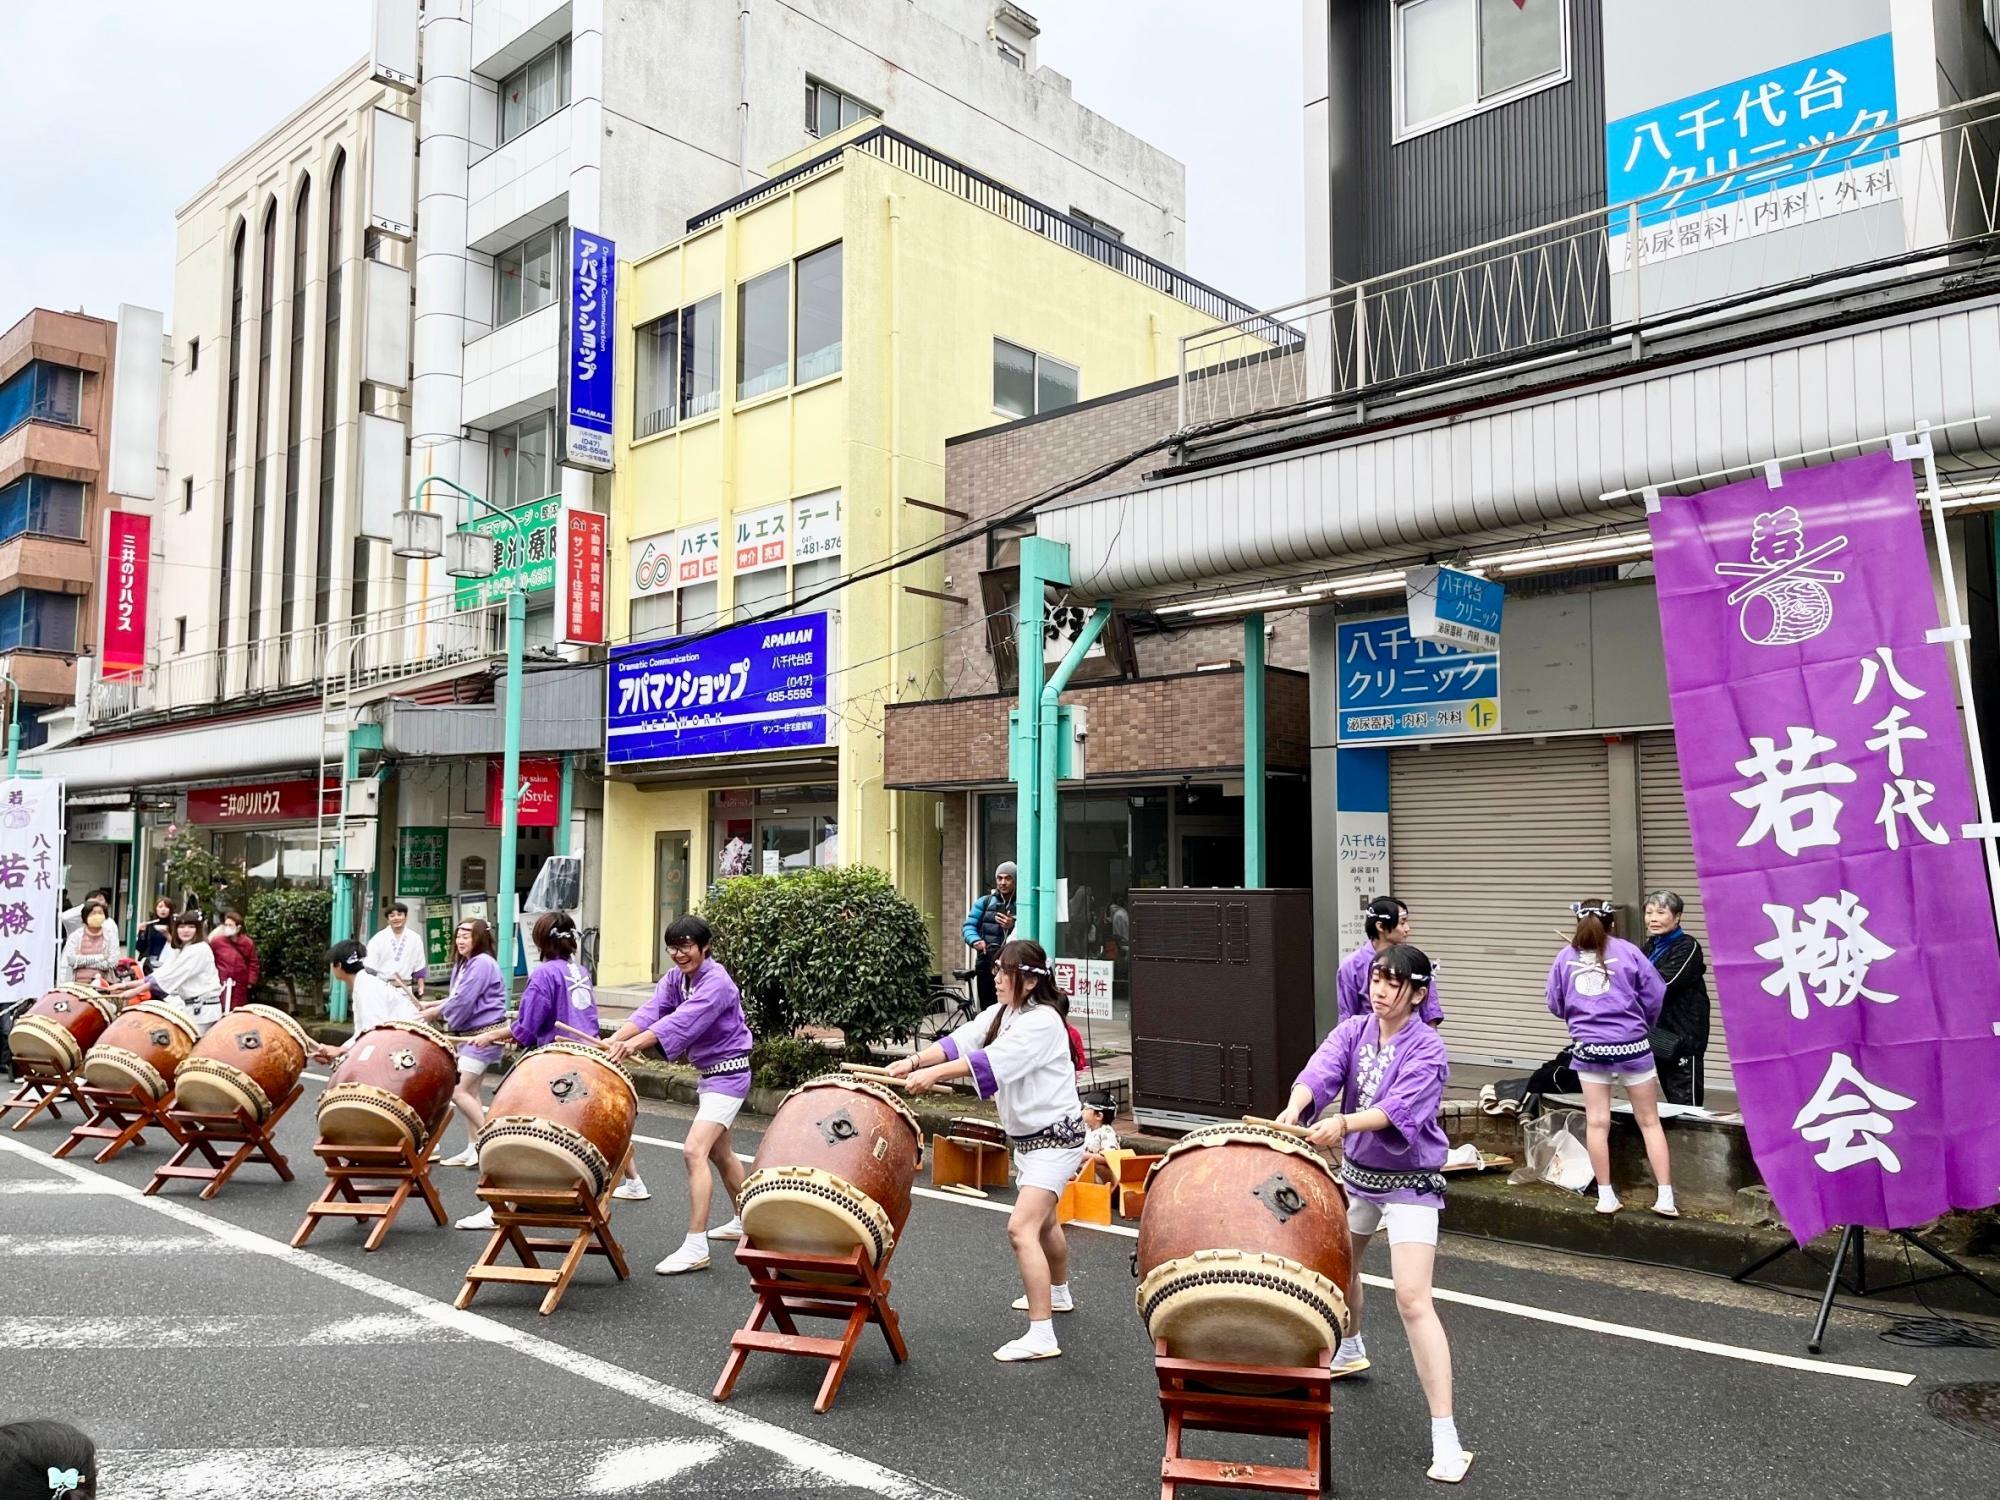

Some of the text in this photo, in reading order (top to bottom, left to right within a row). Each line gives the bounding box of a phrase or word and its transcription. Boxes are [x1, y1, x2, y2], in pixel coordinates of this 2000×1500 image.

[1623, 66, 1848, 173] 八千代台
[1657, 108, 1889, 211] クリニック
[579, 238, 598, 381] アパマンショップ
[600, 245, 610, 352] Dramatic Communication
[576, 407, 606, 420] APAMAN
[738, 550, 755, 566] 仲介
[116, 533, 137, 633] 三井のリハウス
[1441, 573, 1484, 603] 八千代台
[1455, 600, 1500, 628] クリニック
[762, 628, 813, 650] APAMAN
[618, 652, 700, 672] Dramatic Communication
[771, 652, 813, 670] 八千代台店
[617, 656, 751, 715] アパマンショップ
[786, 674, 813, 689] (047)
[1346, 659, 1487, 701] クリニック
[766, 687, 813, 704] 485-5595
[1346, 709, 1463, 733] 泌尿器科・内科・外科
[1470, 703, 1493, 728] 1F
[1852, 645, 1951, 852] 八千代
[8, 789, 23, 806] 若
[219, 789, 281, 817] 三井のリハウス
[1340, 834, 1386, 848] 八千代台
[31, 832, 52, 891] 八千代
[1340, 849, 1386, 862] クリニック
[0, 851, 35, 987] 若撥会
[1729, 723, 1918, 1175] 若撥会
